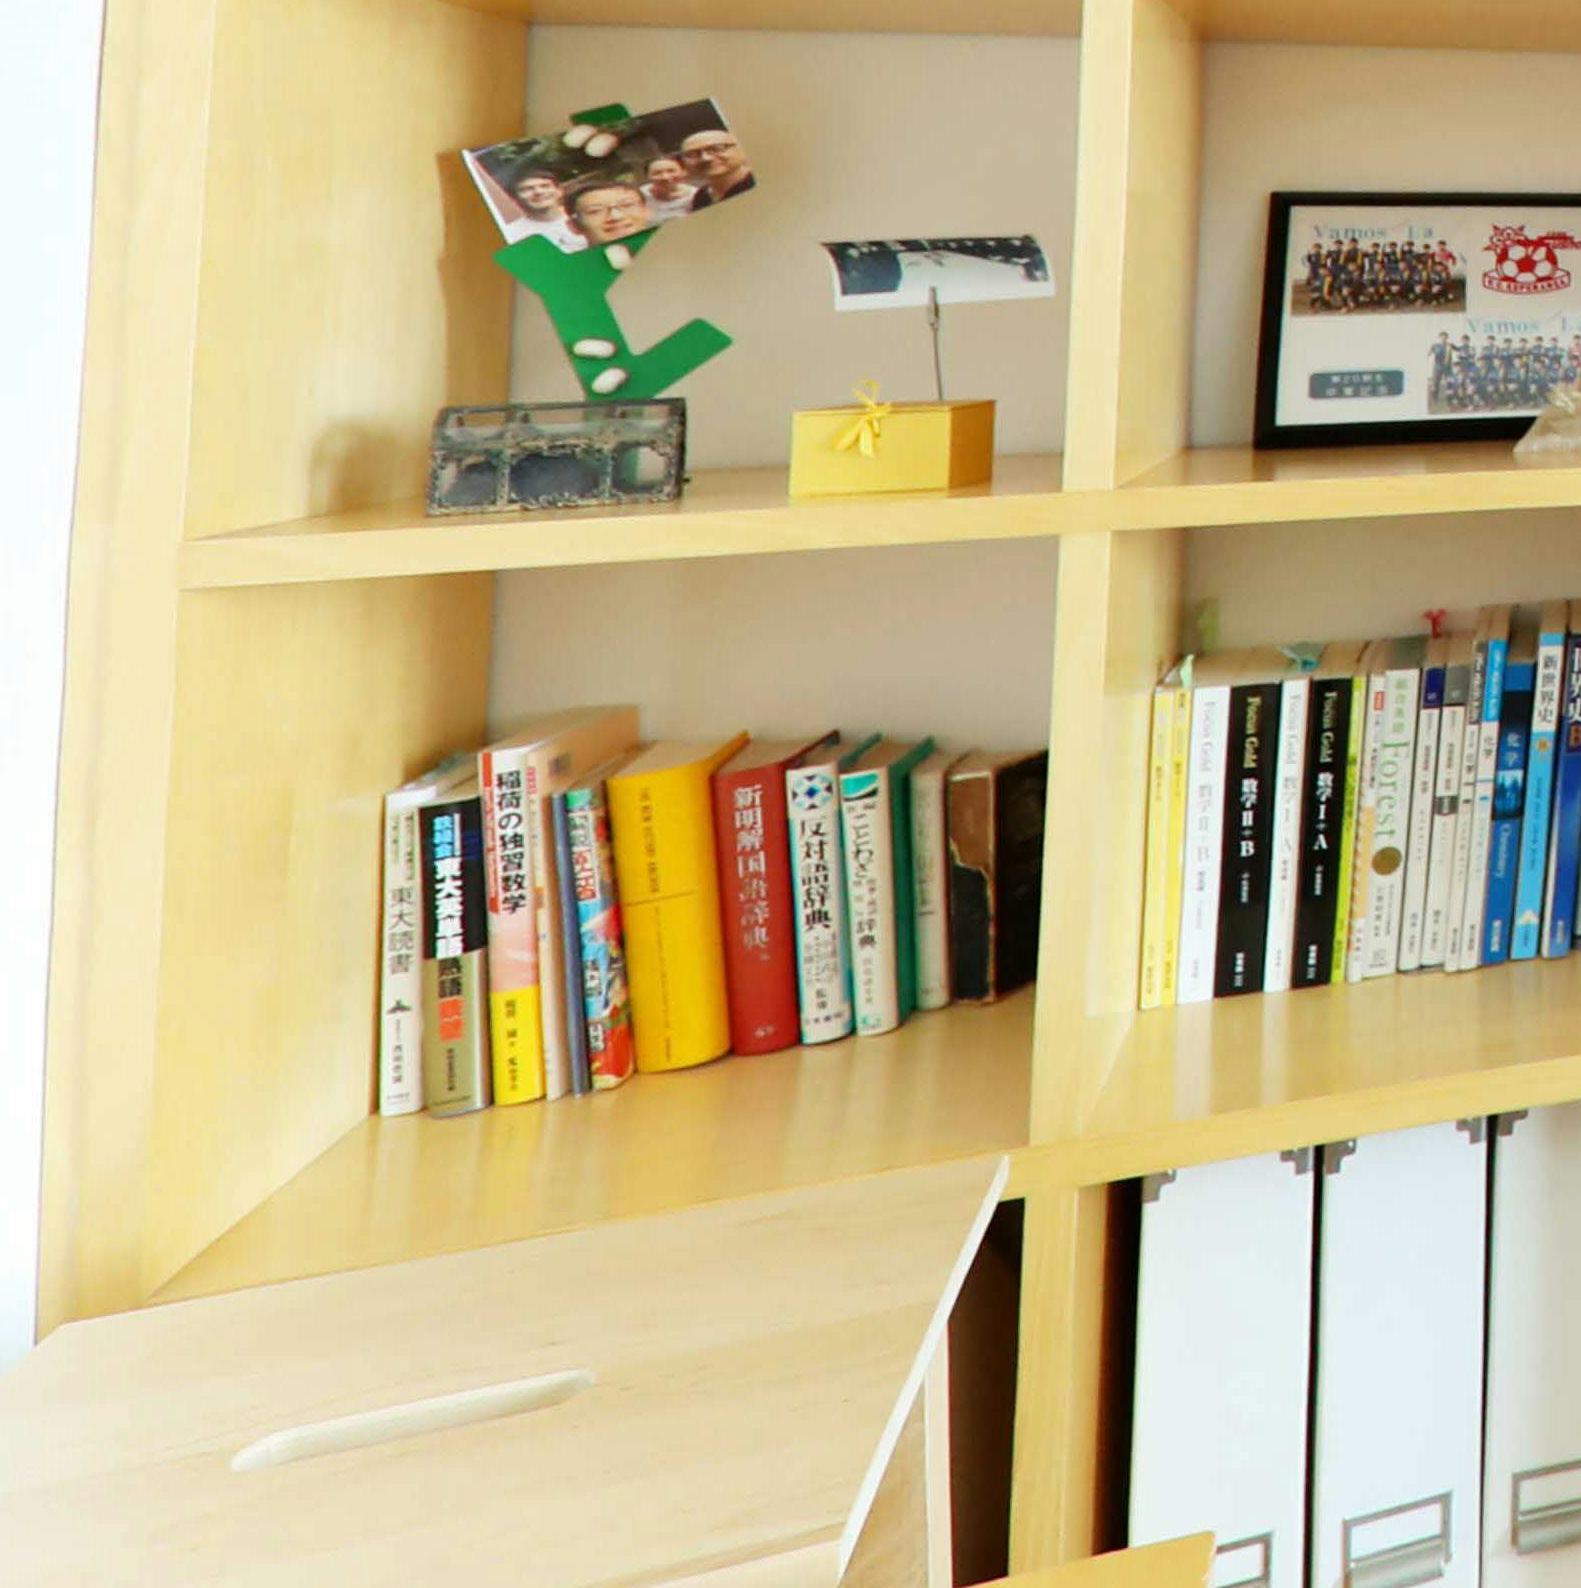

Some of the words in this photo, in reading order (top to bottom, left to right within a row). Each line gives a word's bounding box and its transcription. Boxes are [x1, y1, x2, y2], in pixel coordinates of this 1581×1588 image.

[1242, 734, 1261, 769] Gold
[1373, 740, 1411, 839] Forest
[495, 769, 527, 915] 稲荷の独習数学
[732, 783, 771, 950] 新明解国語辞典
[800, 818, 831, 930] 反対語辞典
[389, 887, 415, 975] 東大読書
